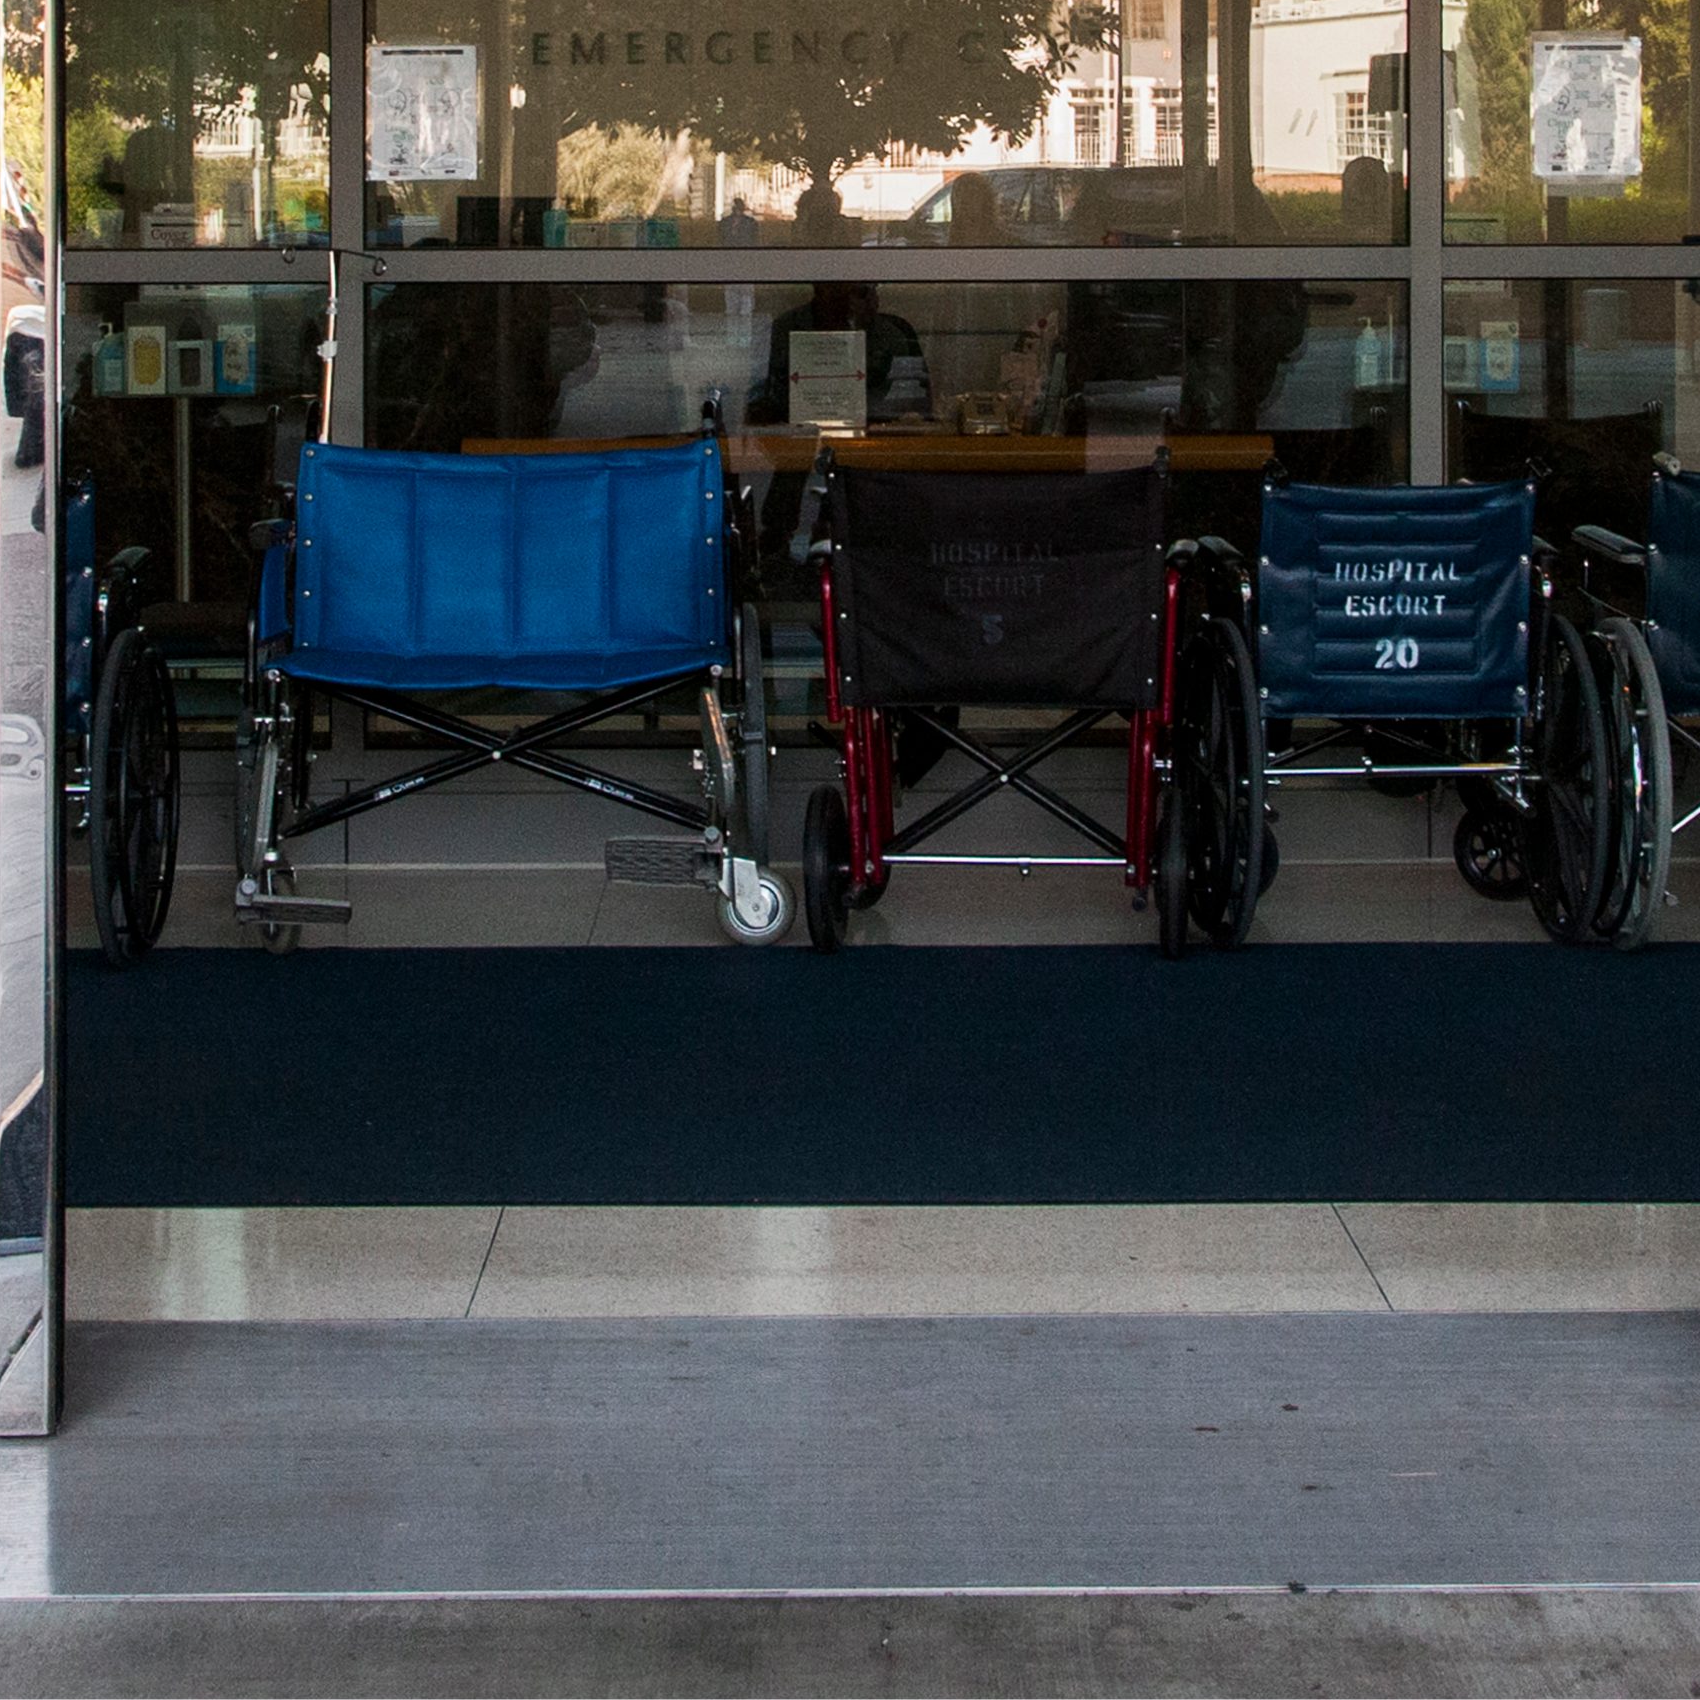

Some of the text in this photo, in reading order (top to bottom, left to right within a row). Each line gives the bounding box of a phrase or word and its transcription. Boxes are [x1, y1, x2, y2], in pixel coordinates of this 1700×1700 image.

[531, 31, 912, 65] EMERGENCY
[930, 540, 1060, 564] HOSPITAL
[1334, 559, 1460, 582] HOSPITAL
[1345, 595, 1446, 617] ESCORT
[1375, 638, 1419, 669] 20
